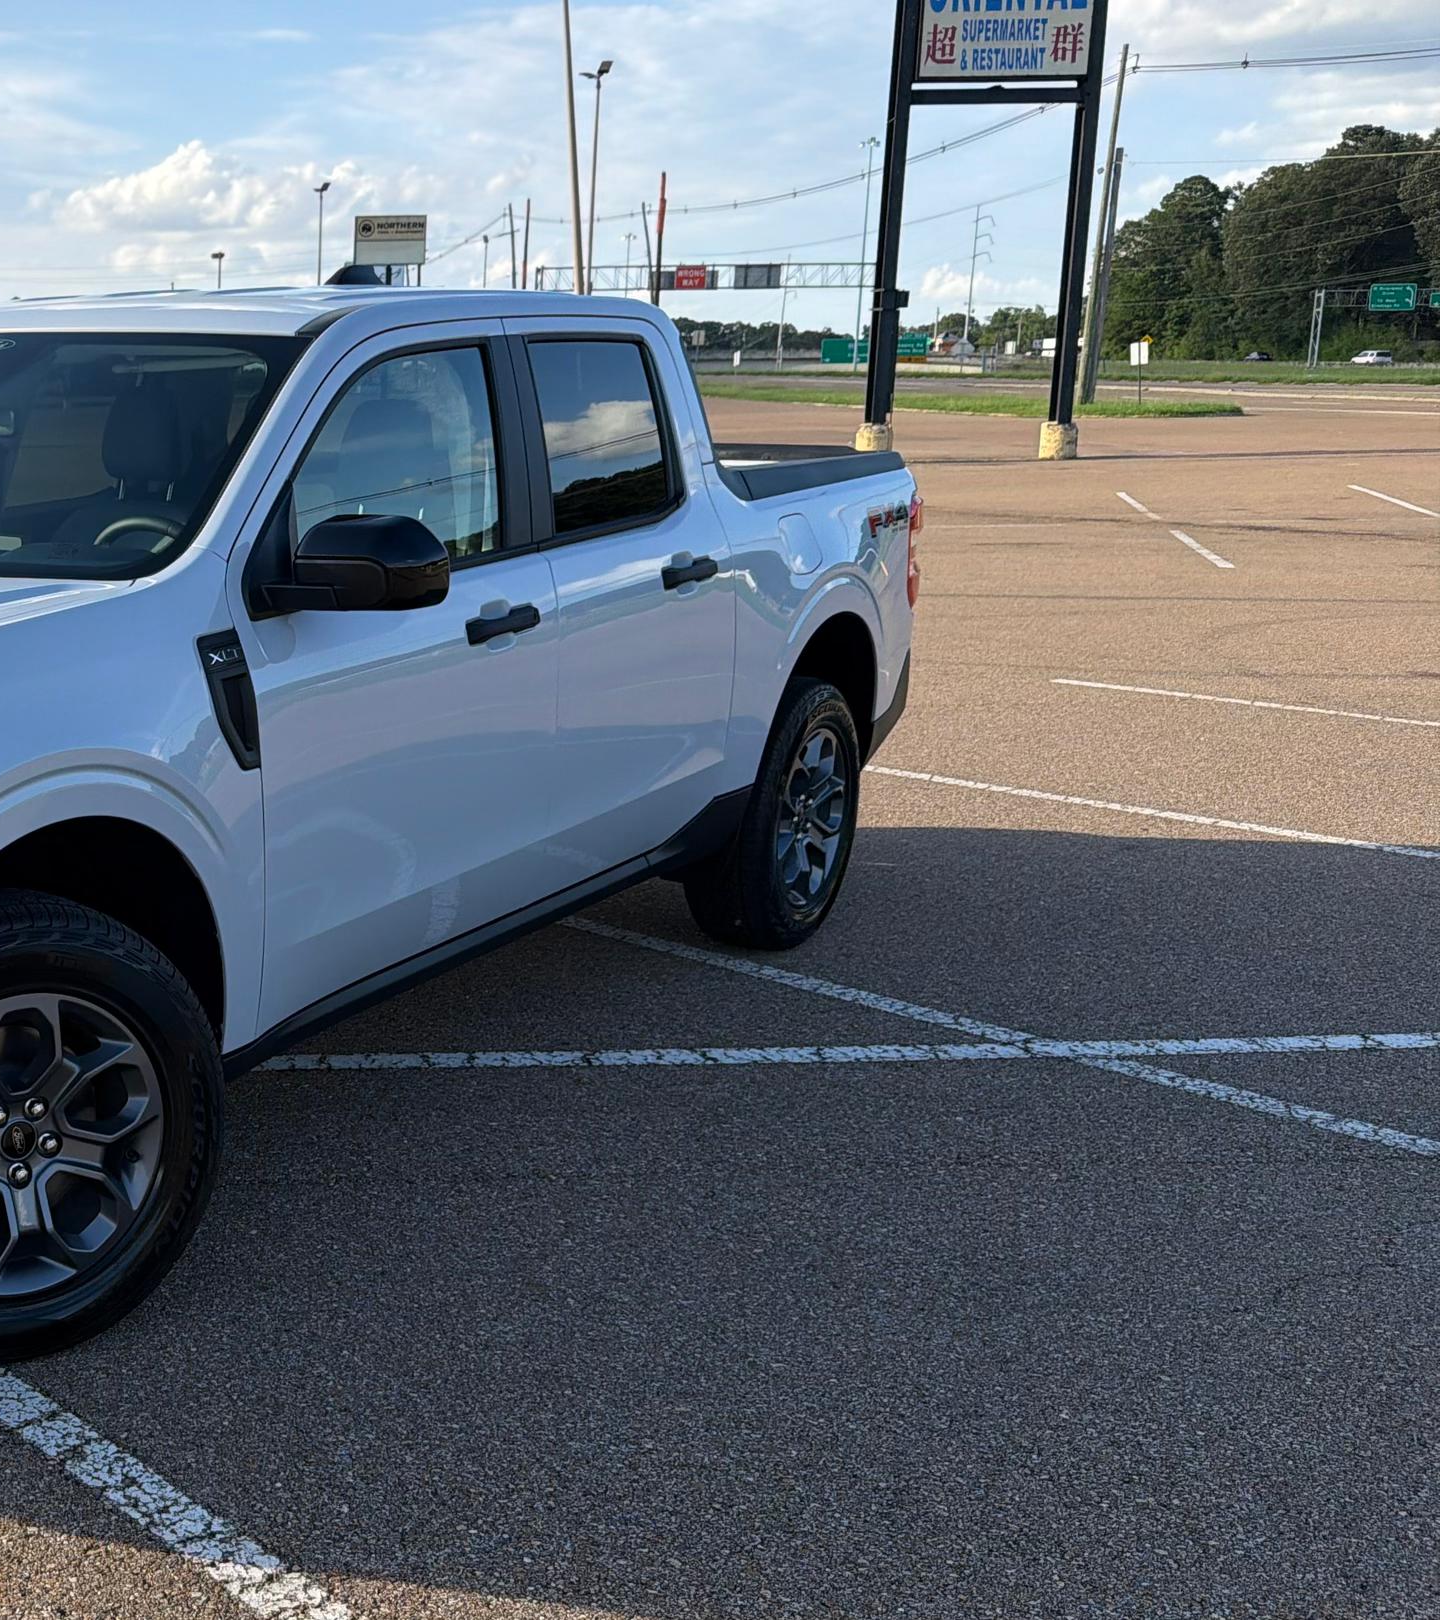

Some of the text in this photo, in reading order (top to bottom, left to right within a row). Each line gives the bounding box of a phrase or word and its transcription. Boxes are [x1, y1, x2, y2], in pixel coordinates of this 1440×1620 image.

[961, 18, 1048, 42] SUPERMARKET
[924, 23, 957, 66] 超
[1050, 22, 1084, 64] 群
[960, 47, 1046, 71] & RESTAURANT
[376, 221, 425, 230] NORTHERN
[677, 268, 705, 278] WRONG
[682, 278, 700, 287] WAY
[208, 647, 240, 665] XLT
